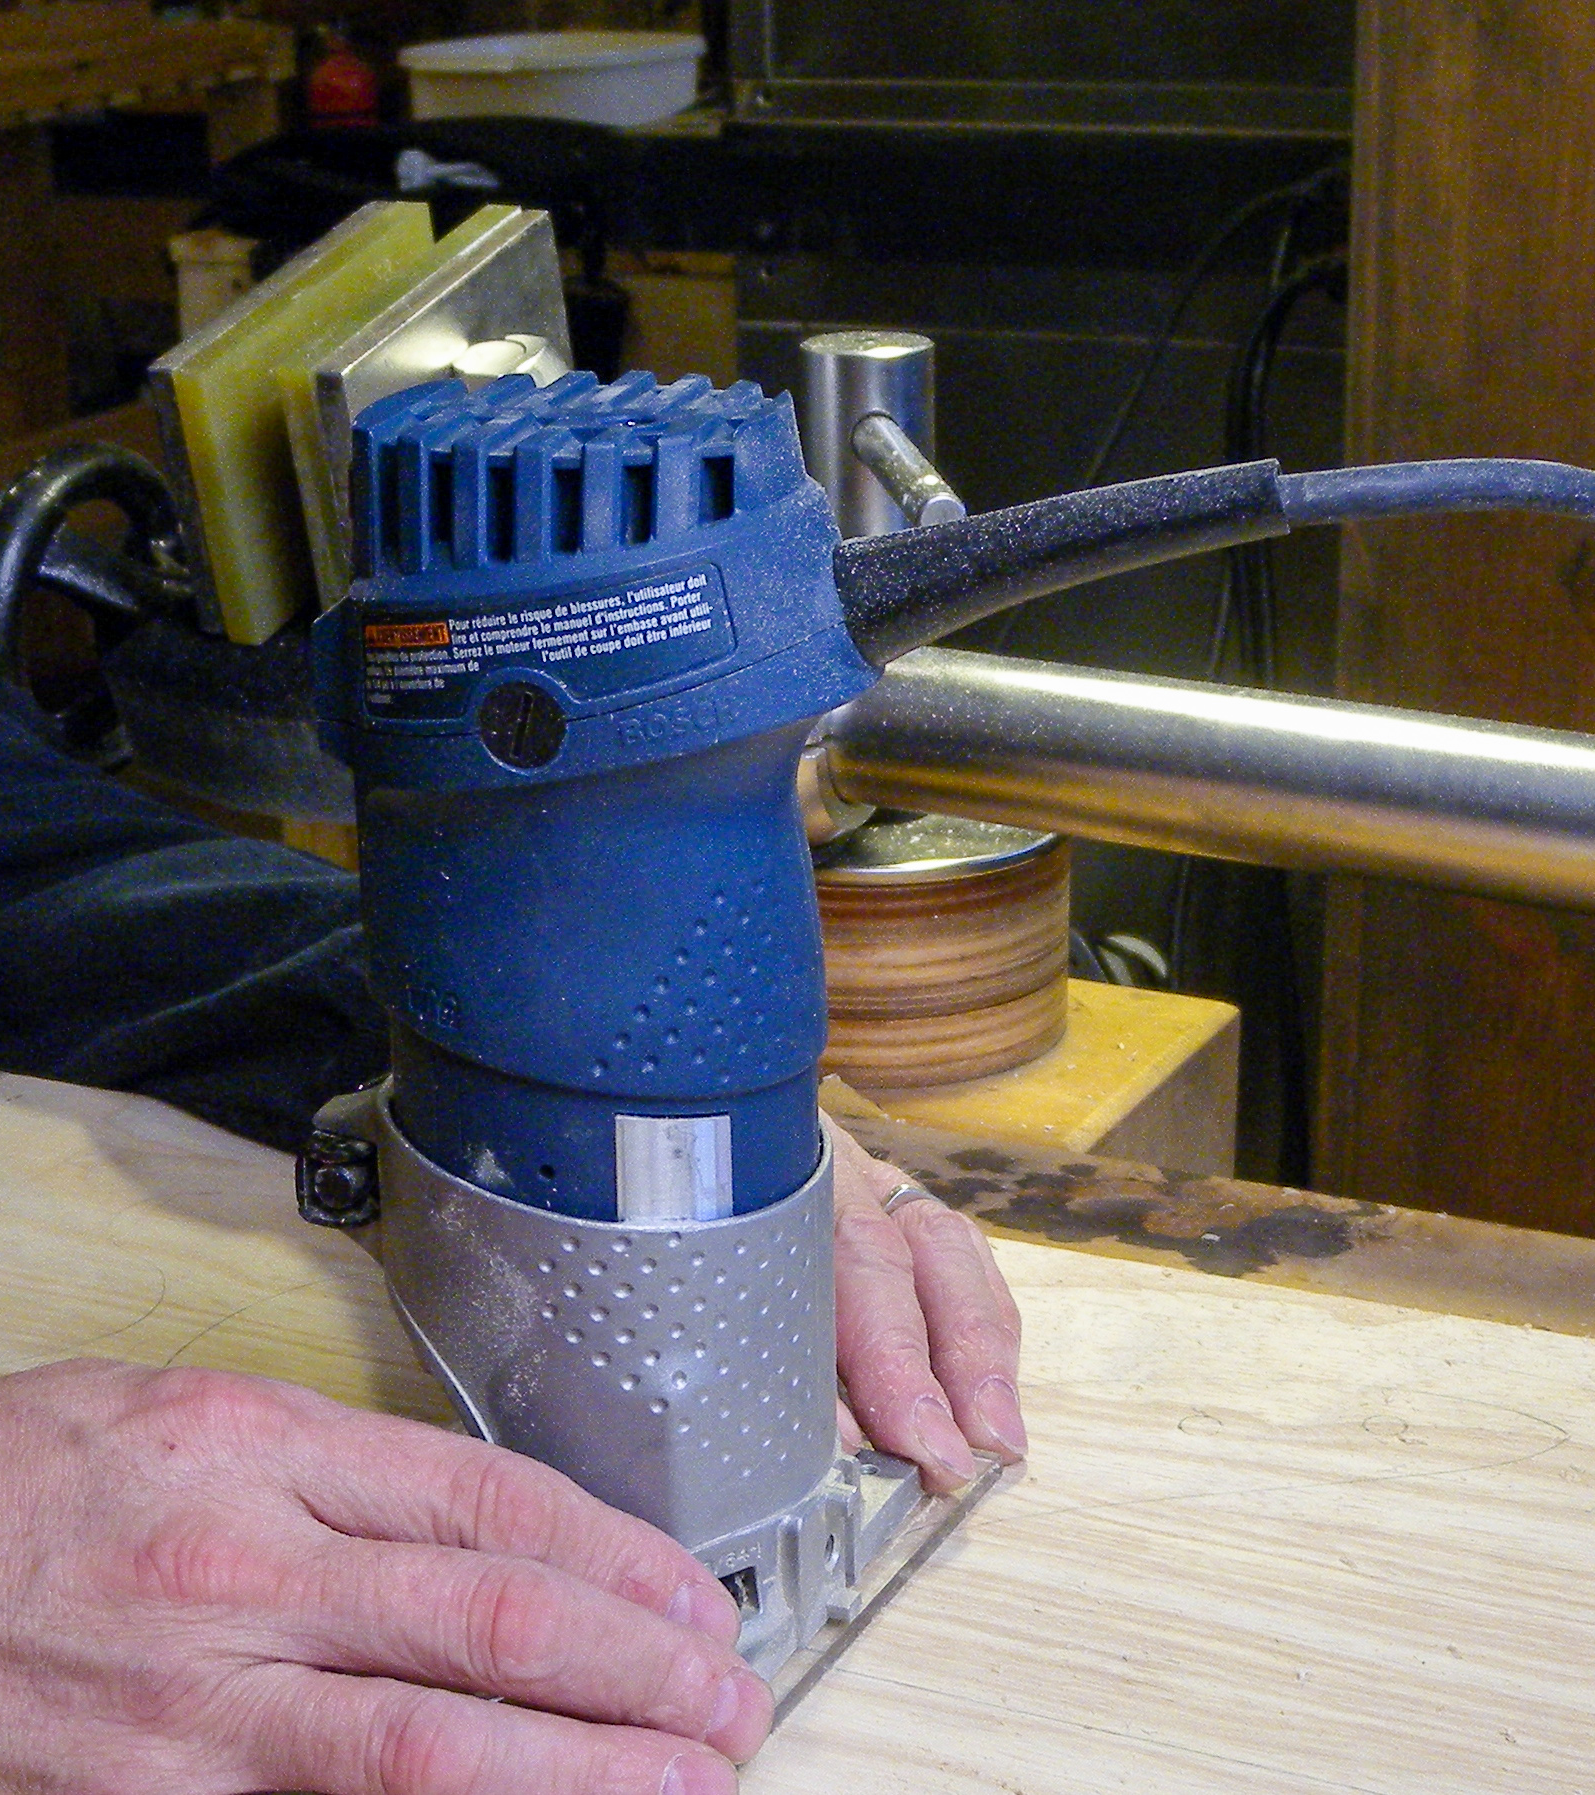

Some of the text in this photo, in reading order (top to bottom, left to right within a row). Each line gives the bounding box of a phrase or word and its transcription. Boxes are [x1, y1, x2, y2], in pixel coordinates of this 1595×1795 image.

[448, 618, 470, 631] Pour
[472, 614, 506, 630] réduire
[507, 612, 519, 625] le
[520, 608, 553, 623] risque
[554, 604, 569, 618] de
[626, 580, 686, 604] l'utilisateur
[687, 573, 708, 590] doit
[469, 631, 479, 644] et
[480, 624, 539, 642] comprendre
[540, 621, 552, 634] le
[553, 614, 593, 631] manuel
[594, 600, 669, 625] d'instructions.
[670, 592, 702, 609] Porter
[452, 646, 483, 660] Serrez
[484, 643, 495, 656] le
[496, 640, 531, 654] moteur
[532, 629, 590, 650] fermement
[590, 627, 608, 641] sur
[609, 616, 659, 637] l'embase
[660, 608, 689, 625] avant
[689, 601, 714, 619] utili-
[467, 660, 480, 672] de
[541, 645, 573, 662] l'outil
[573, 644, 588, 658] de
[589, 639, 622, 654] coupe
[623, 632, 645, 648] doit
[645, 629, 668, 644] être
[669, 618, 712, 638] inférieur
